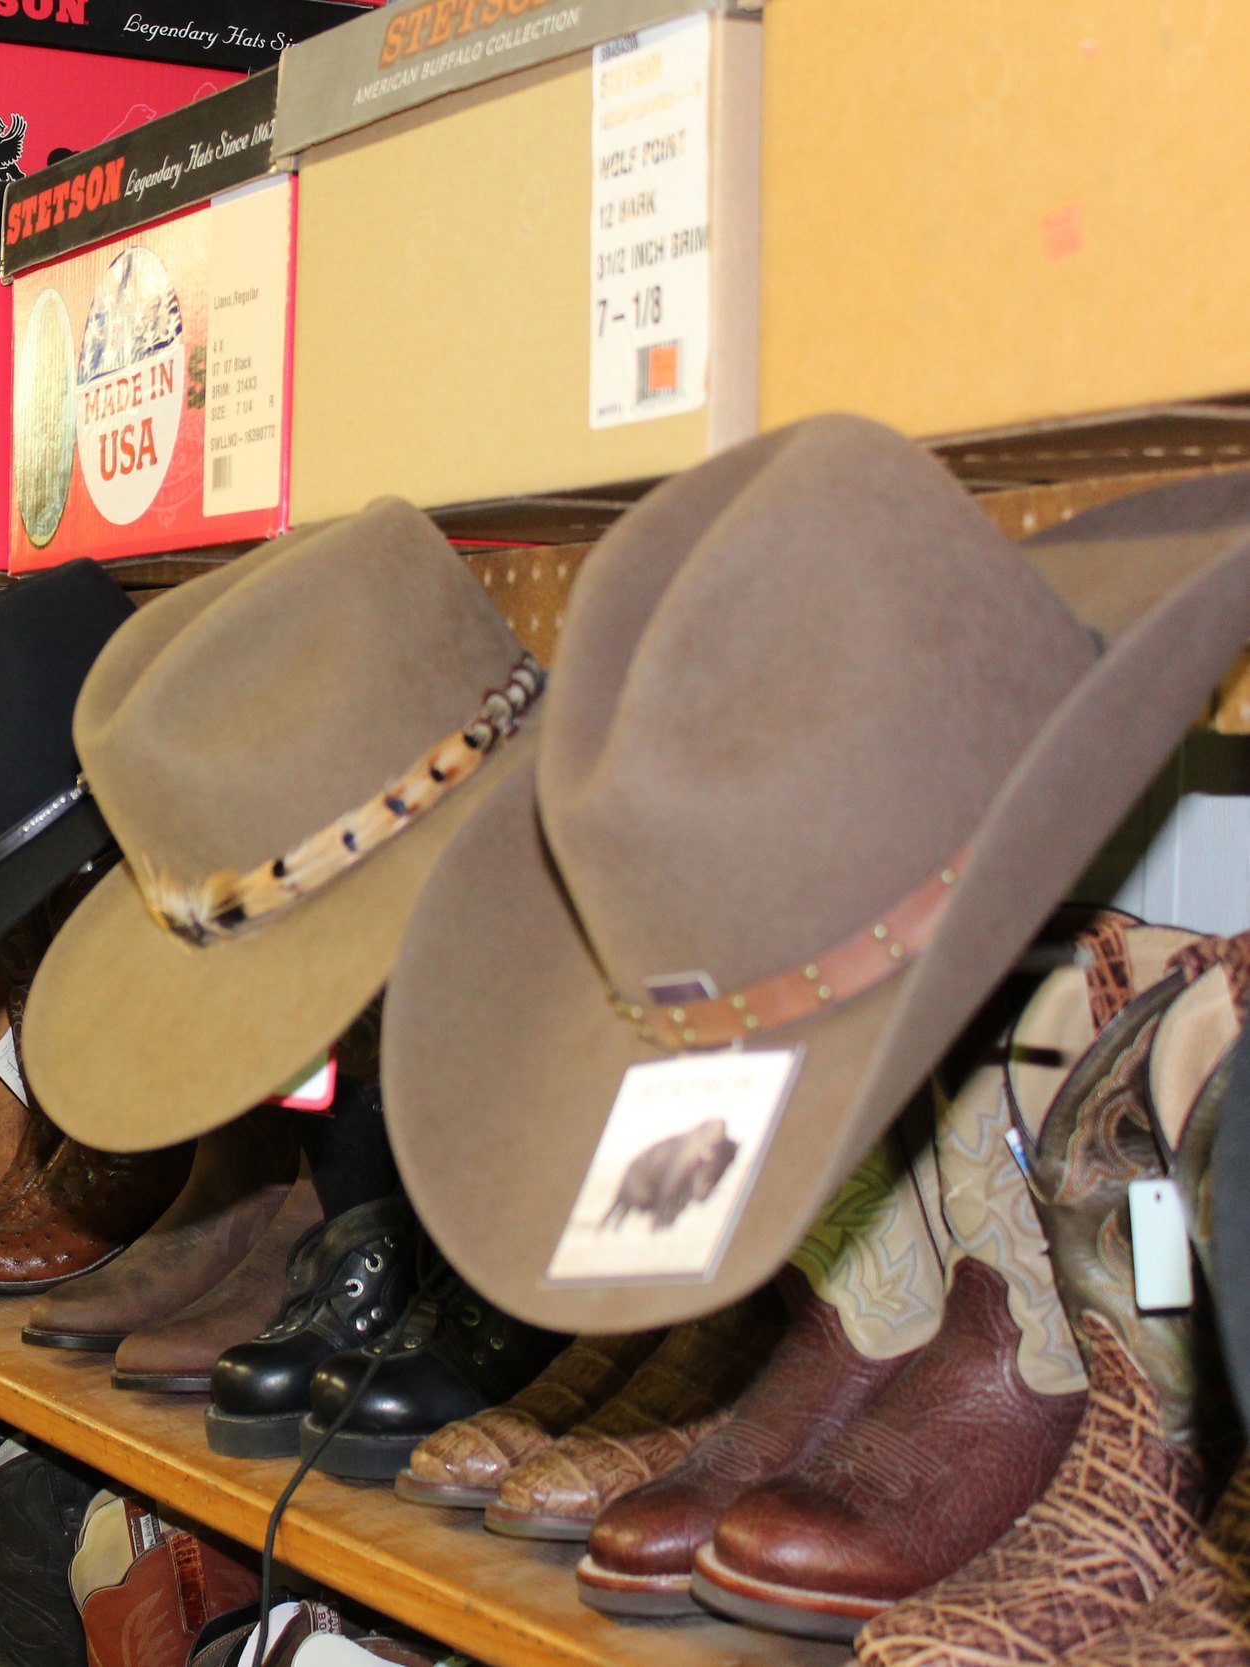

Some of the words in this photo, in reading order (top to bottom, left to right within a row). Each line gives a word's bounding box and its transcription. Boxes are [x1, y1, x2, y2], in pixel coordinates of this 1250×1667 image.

[123, 13, 219, 50] Legendary
[222, 25, 267, 49] Hats
[353, 67, 421, 106] AMERICAN
[420, 41, 483, 81] BUFFALO
[485, 6, 582, 56] COLLECTION
[6, 156, 126, 246] STETSON
[124, 154, 183, 202] Legendary
[184, 141, 215, 173] Hats
[215, 130, 249, 159] Since
[249, 118, 276, 147] 1865
[630, 233, 665, 269] INCH
[84, 372, 142, 425] MADE
[150, 359, 174, 400] IN
[99, 417, 158, 481] USA
